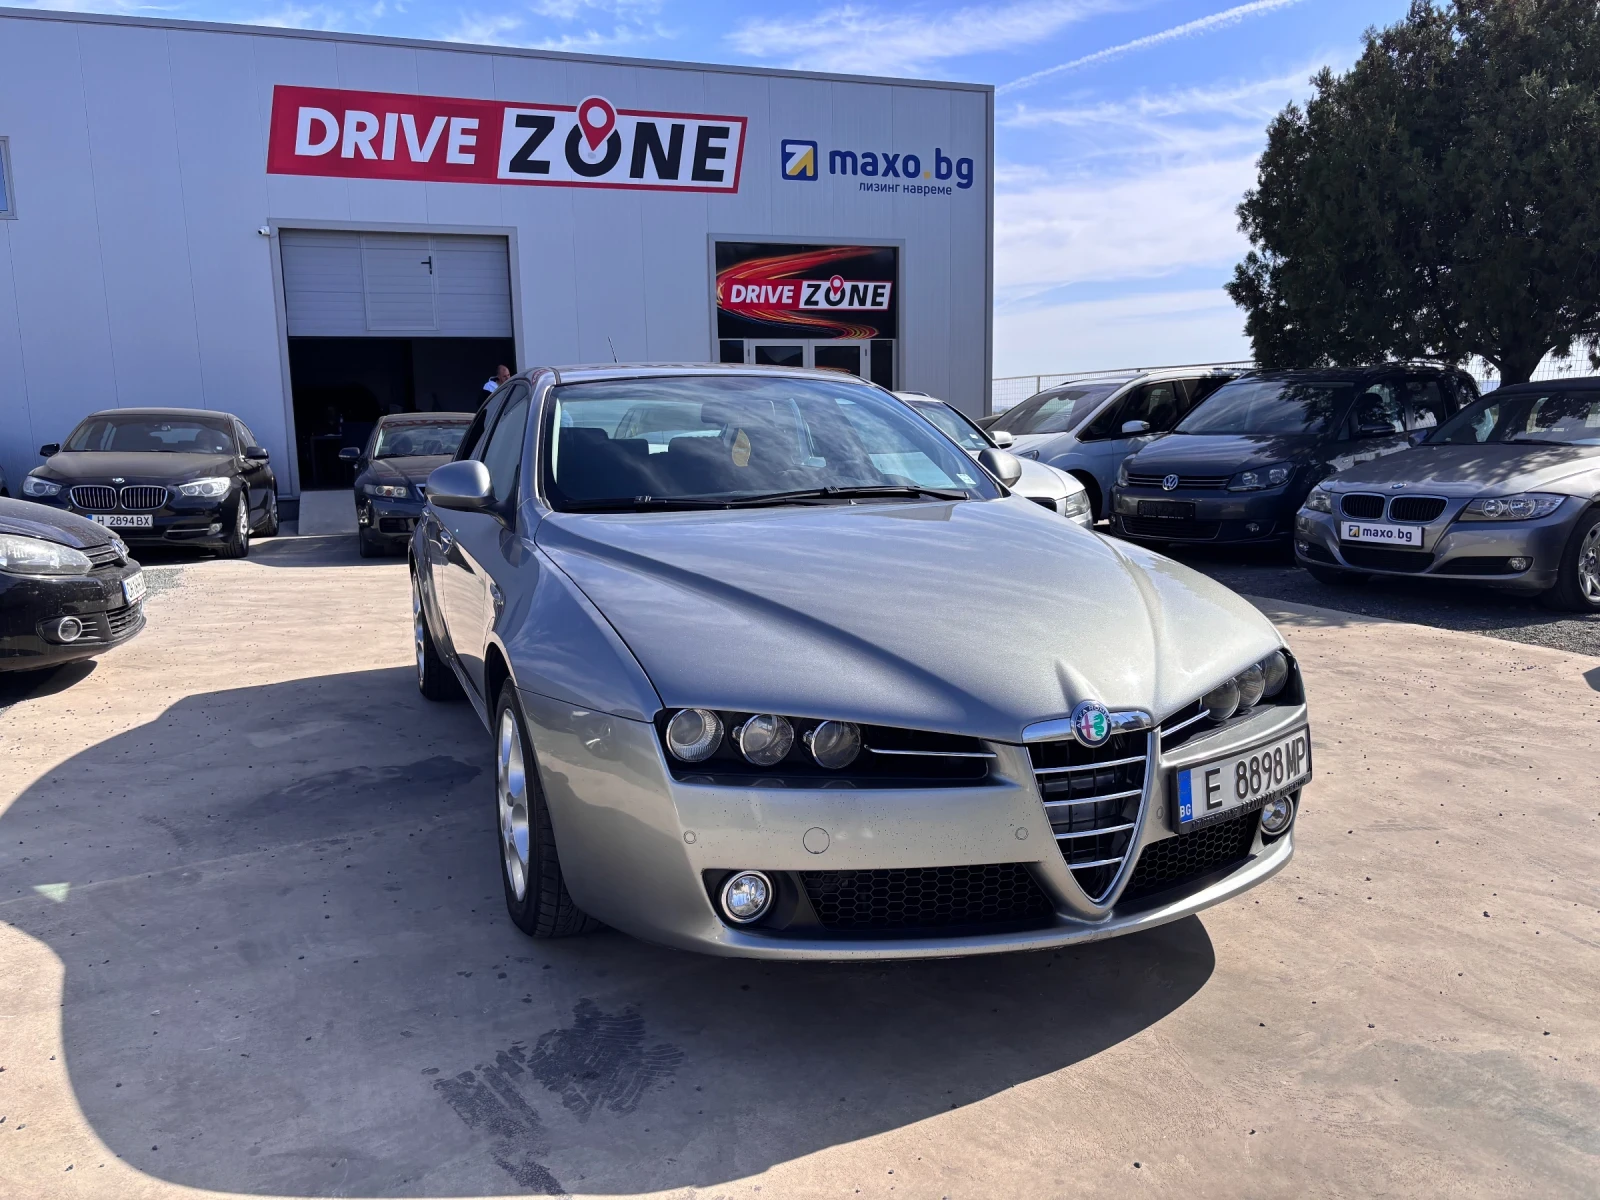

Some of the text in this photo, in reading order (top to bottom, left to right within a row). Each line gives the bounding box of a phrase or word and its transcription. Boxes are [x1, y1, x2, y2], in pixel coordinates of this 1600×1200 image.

[294, 106, 731, 182] DRIVE ZONE
[829, 147, 974, 189] maxo.bg
[858, 182, 952, 196] лизинг навреме
[730, 283, 887, 307] DRIVE ZONE
[1362, 528, 1412, 542] maxo.bg
[1205, 768, 1222, 810] E
[1179, 804, 1192, 818] BG
